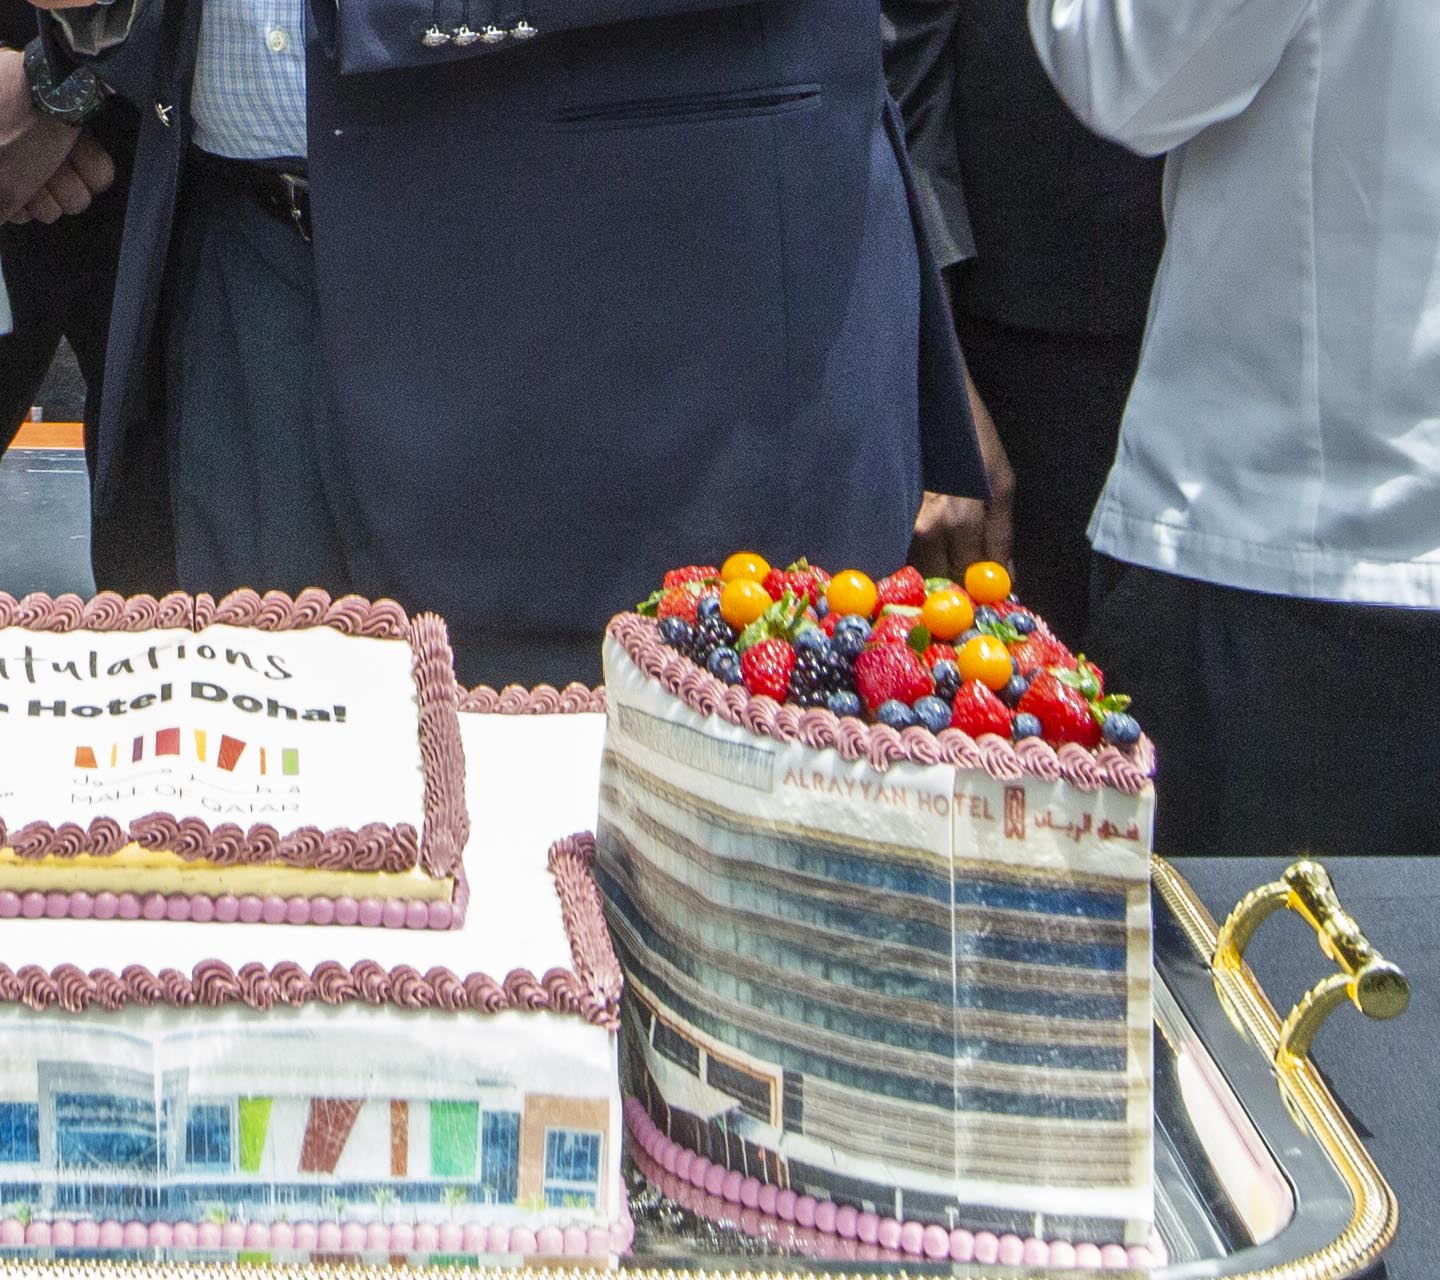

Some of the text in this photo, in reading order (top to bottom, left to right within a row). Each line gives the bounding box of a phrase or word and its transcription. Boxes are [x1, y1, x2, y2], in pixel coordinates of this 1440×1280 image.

[27, 682, 173, 718] Hotel
[190, 681, 347, 723] Doha!
[783, 767, 995, 821] ALRAYYAN HOTEL
